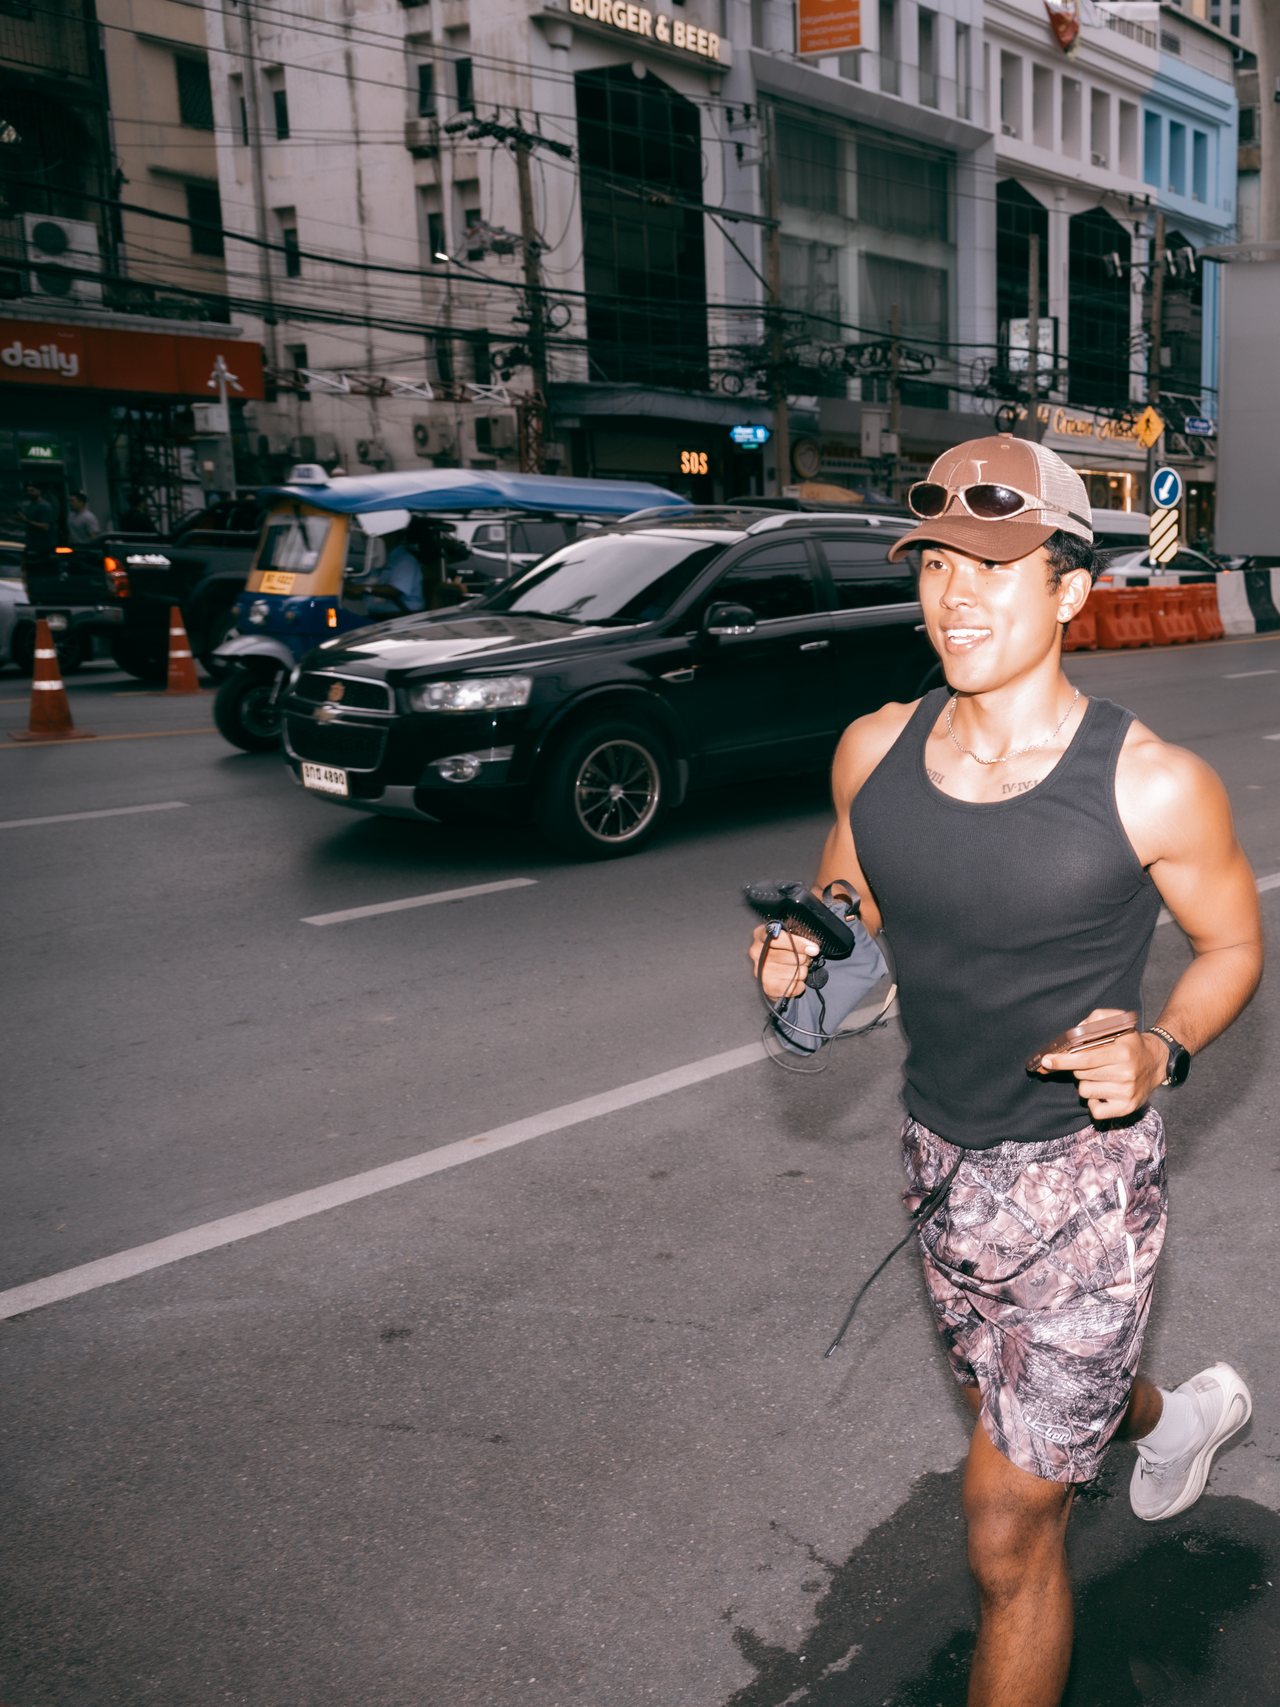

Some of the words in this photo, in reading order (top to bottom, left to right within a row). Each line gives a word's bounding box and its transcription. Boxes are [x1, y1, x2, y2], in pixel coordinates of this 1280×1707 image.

[655, 15, 670, 44] &
[673, 20, 720, 60] BEER
[1, 341, 79, 378] daily
[681, 450, 708, 475] SOS
